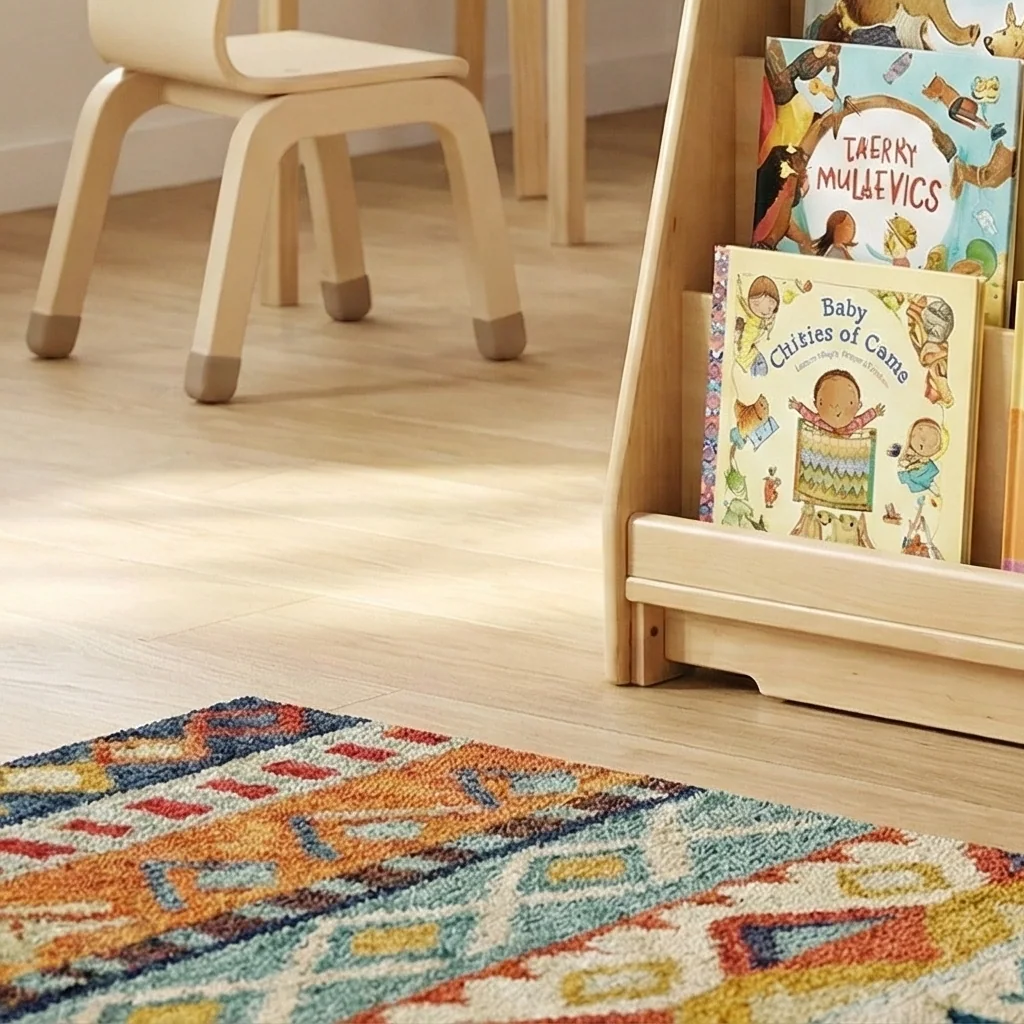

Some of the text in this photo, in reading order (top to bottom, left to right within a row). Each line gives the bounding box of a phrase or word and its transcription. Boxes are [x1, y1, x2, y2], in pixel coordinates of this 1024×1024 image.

[821, 297, 868, 325] Baby
[839, 326, 861, 345] of
[865, 334, 909, 384] Came
